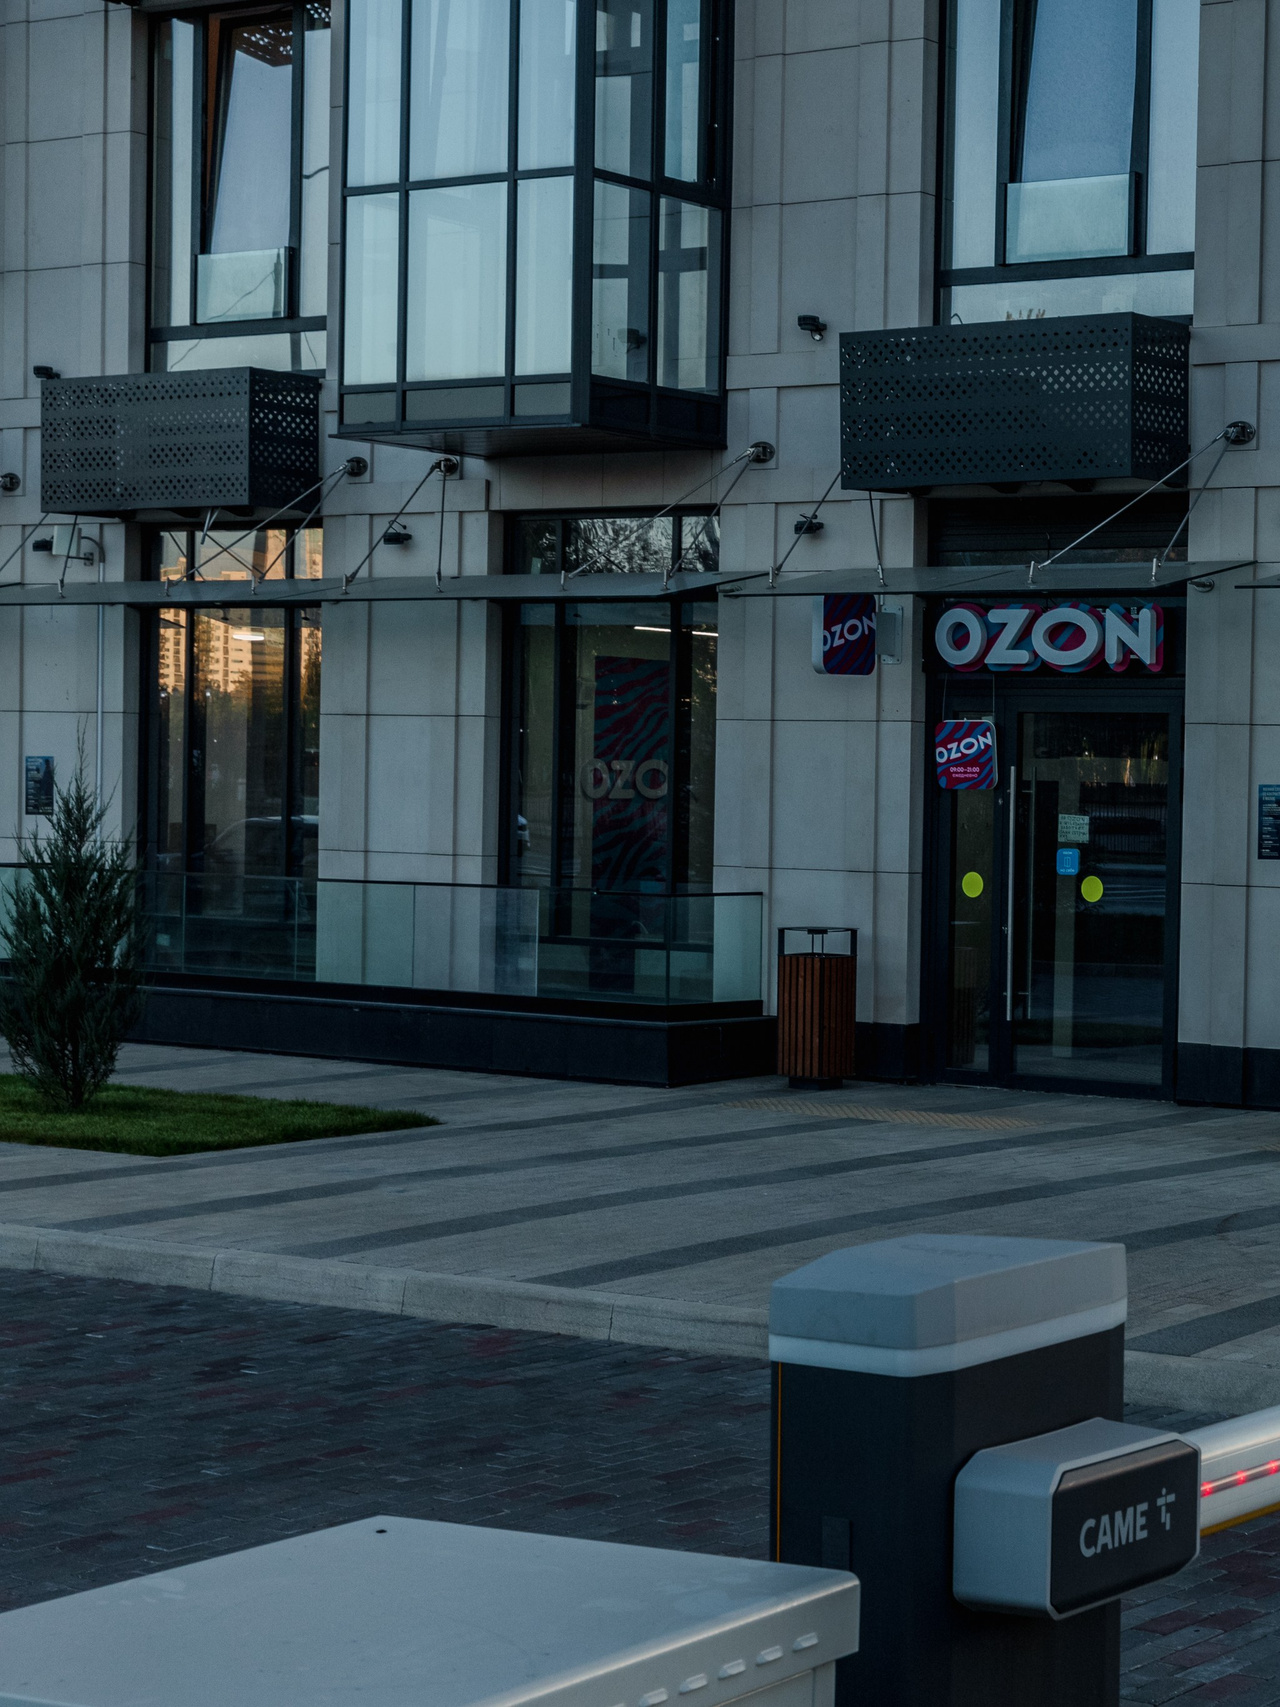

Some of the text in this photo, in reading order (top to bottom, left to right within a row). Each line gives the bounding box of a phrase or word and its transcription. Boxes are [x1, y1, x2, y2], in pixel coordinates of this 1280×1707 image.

[935, 606, 1160, 668] OZON
[936, 731, 993, 764] OZON
[580, 758, 669, 800] OZO
[1079, 1501, 1149, 1558] CAME
